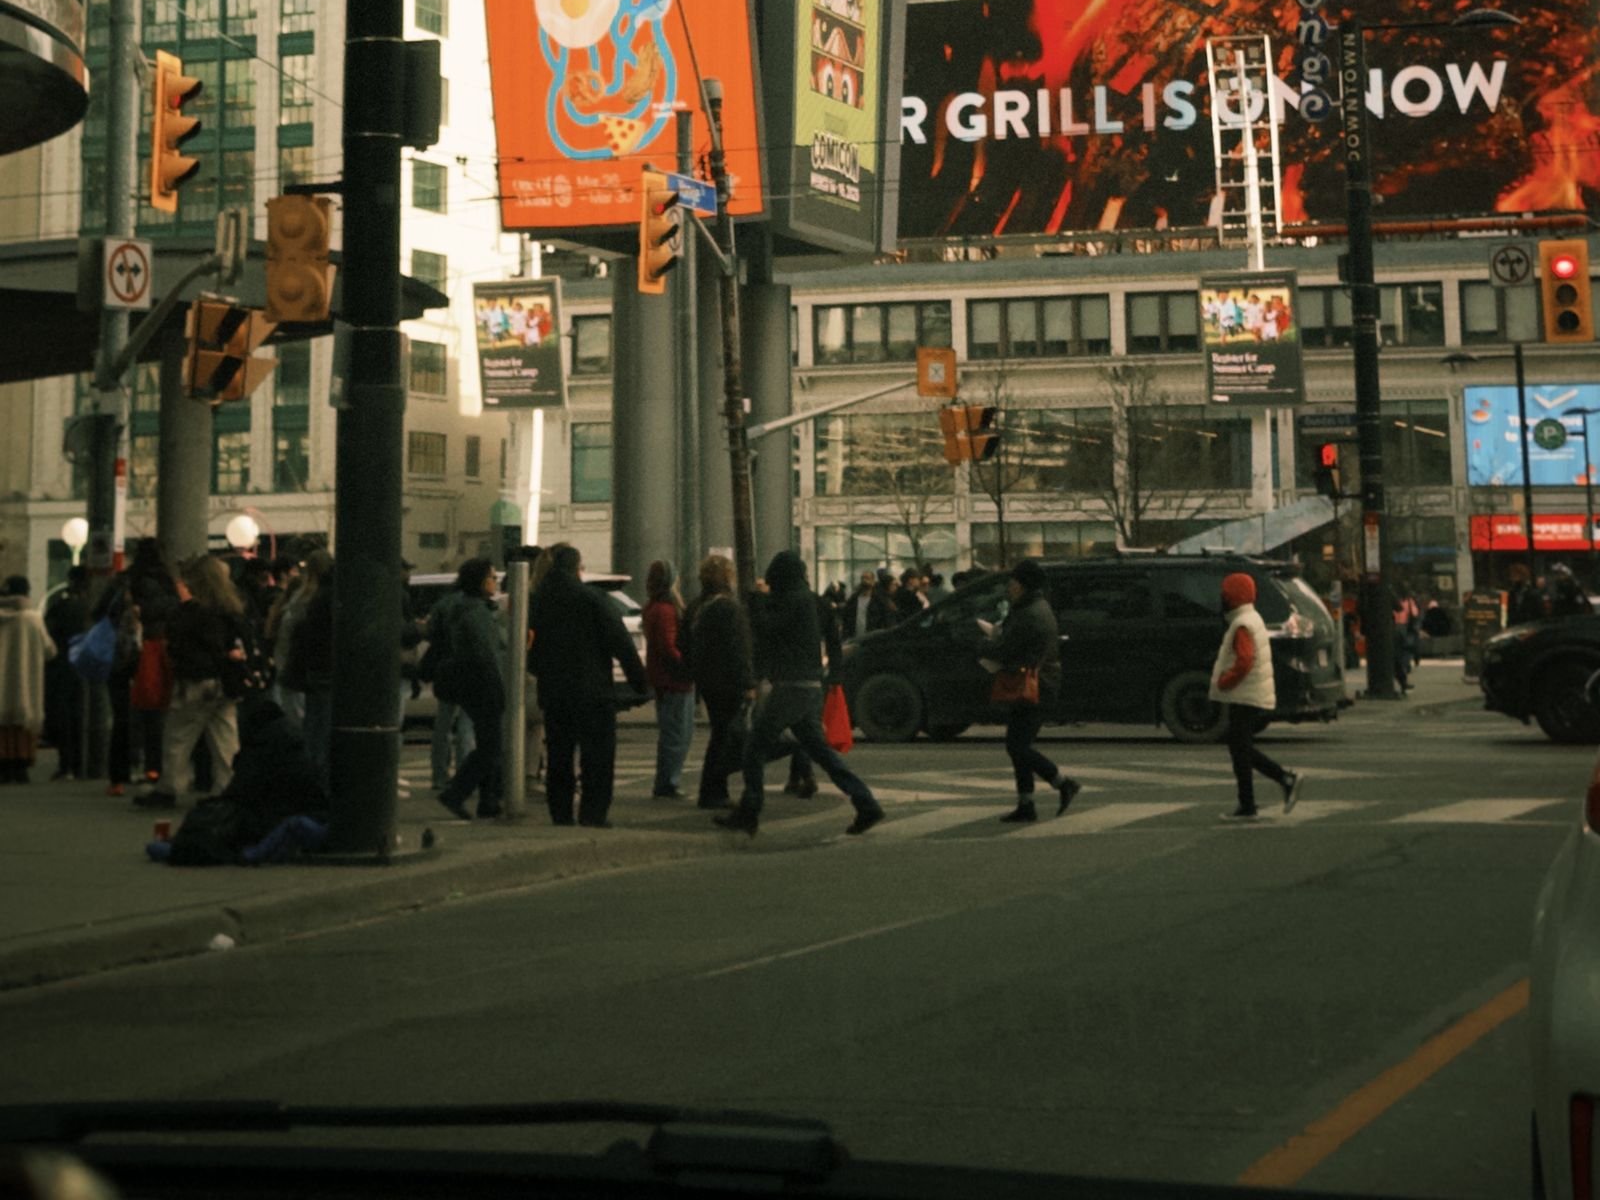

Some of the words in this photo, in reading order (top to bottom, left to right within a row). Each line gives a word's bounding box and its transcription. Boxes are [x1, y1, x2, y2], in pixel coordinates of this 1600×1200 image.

[945, 85, 1124, 143] GRILL
[1142, 80, 1197, 132] IS
[810, 129, 860, 184] COMICON
